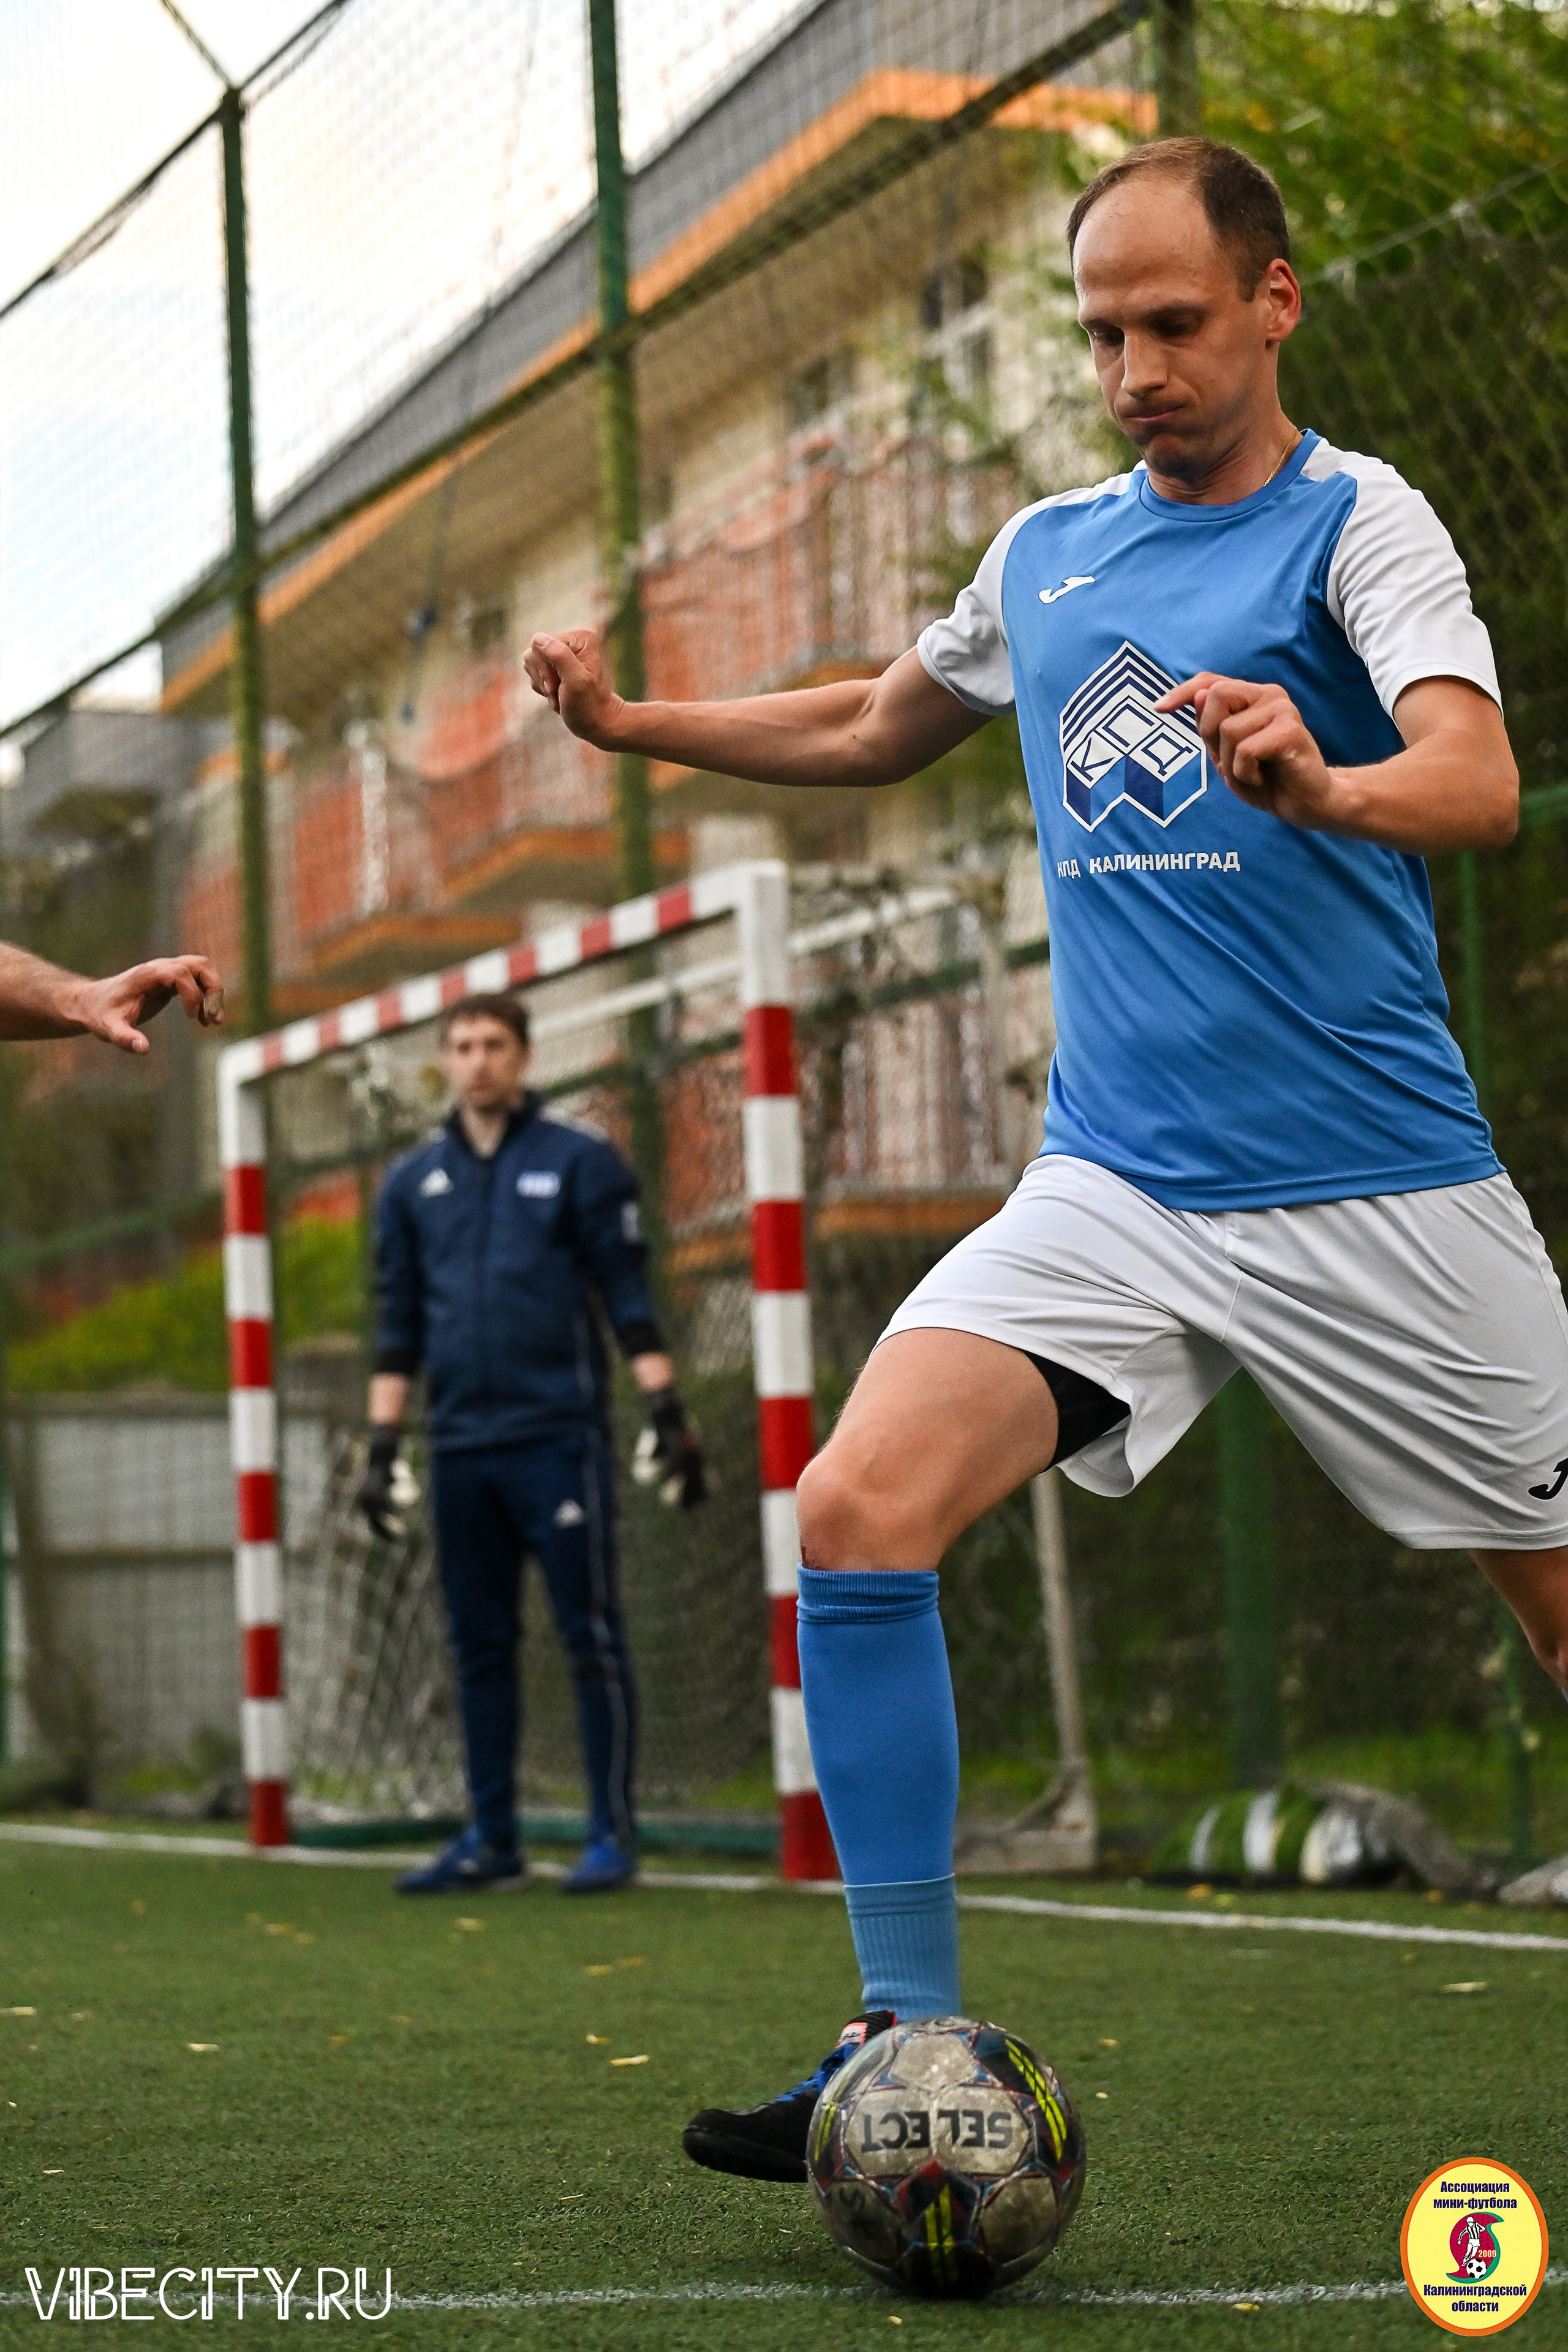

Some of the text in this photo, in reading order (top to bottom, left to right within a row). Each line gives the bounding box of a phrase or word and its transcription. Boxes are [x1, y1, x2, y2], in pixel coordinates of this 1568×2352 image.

[1071, 703, 1193, 782] КПД
[1057, 851, 1241, 879] КПД КАЛИНИНГРАД
[861, 2110, 1012, 2152] SELECT
